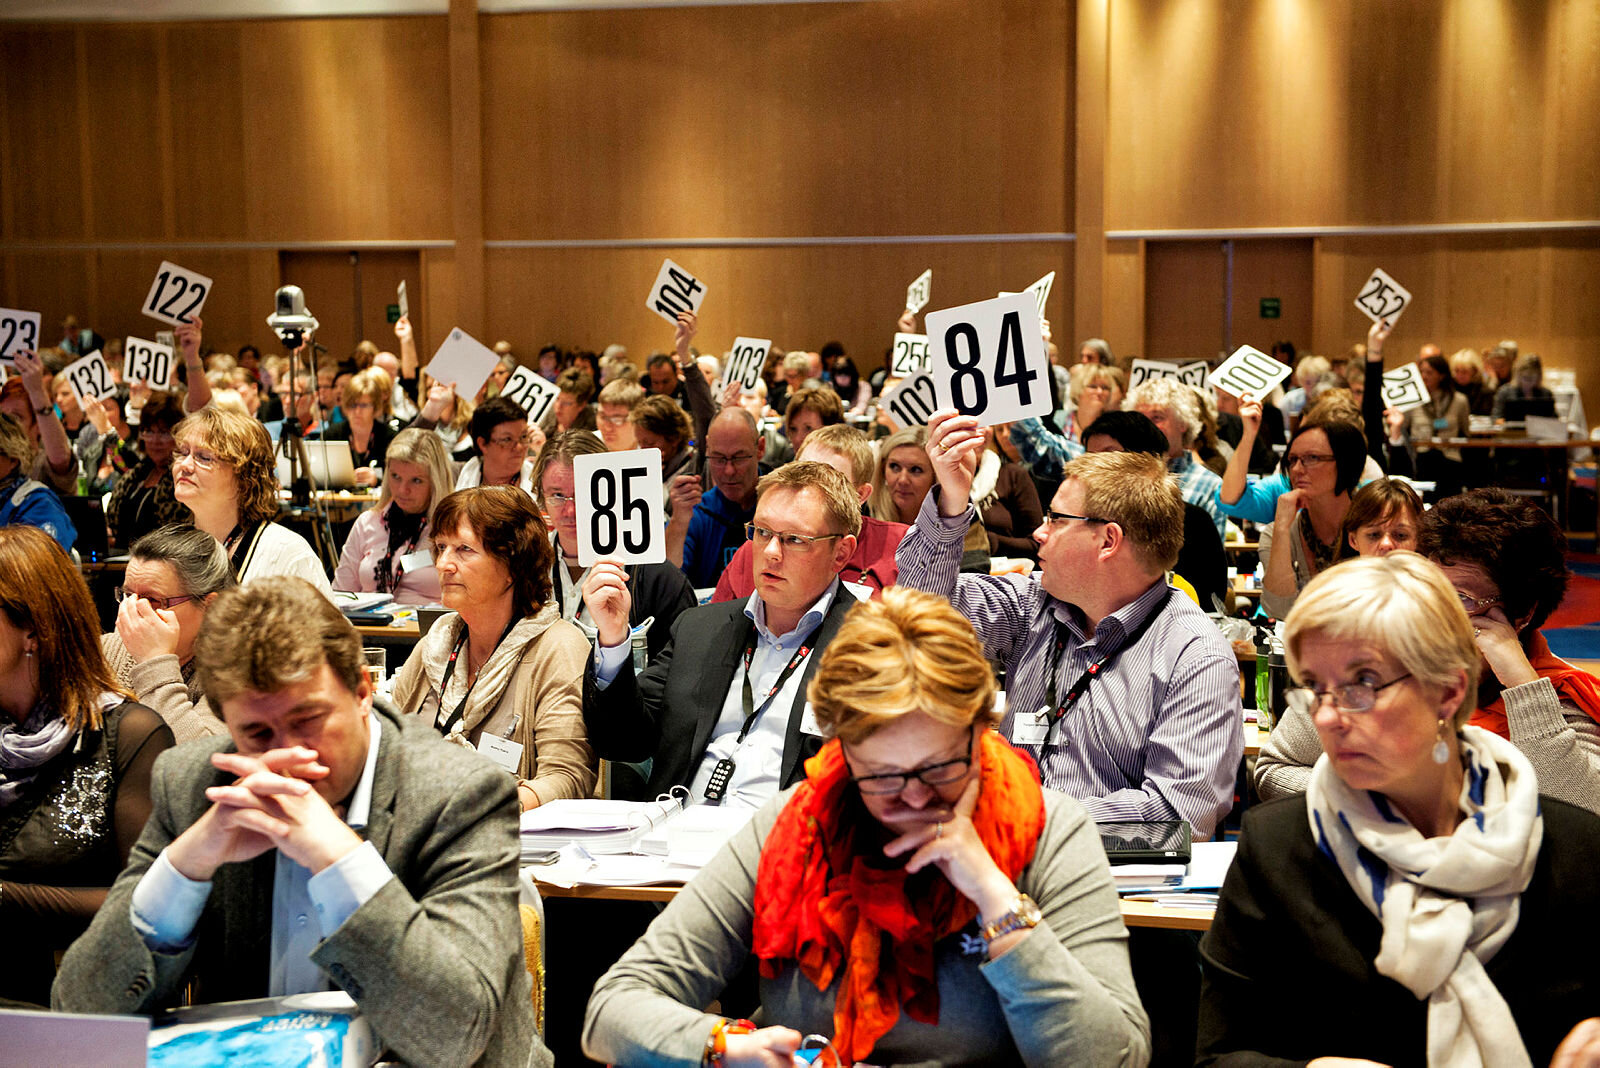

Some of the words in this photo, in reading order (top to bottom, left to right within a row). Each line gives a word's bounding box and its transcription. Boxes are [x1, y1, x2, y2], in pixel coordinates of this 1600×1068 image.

[149, 271, 206, 324] 122
[655, 267, 702, 321] 104
[1358, 277, 1405, 326] 252
[70, 358, 114, 398] 132
[127, 345, 169, 385] 130
[727, 345, 765, 389] 103
[944, 311, 1037, 417] 84
[1220, 352, 1282, 397] 100
[1382, 369, 1422, 406] 257
[509, 374, 554, 423] 261
[591, 467, 651, 556] 85
